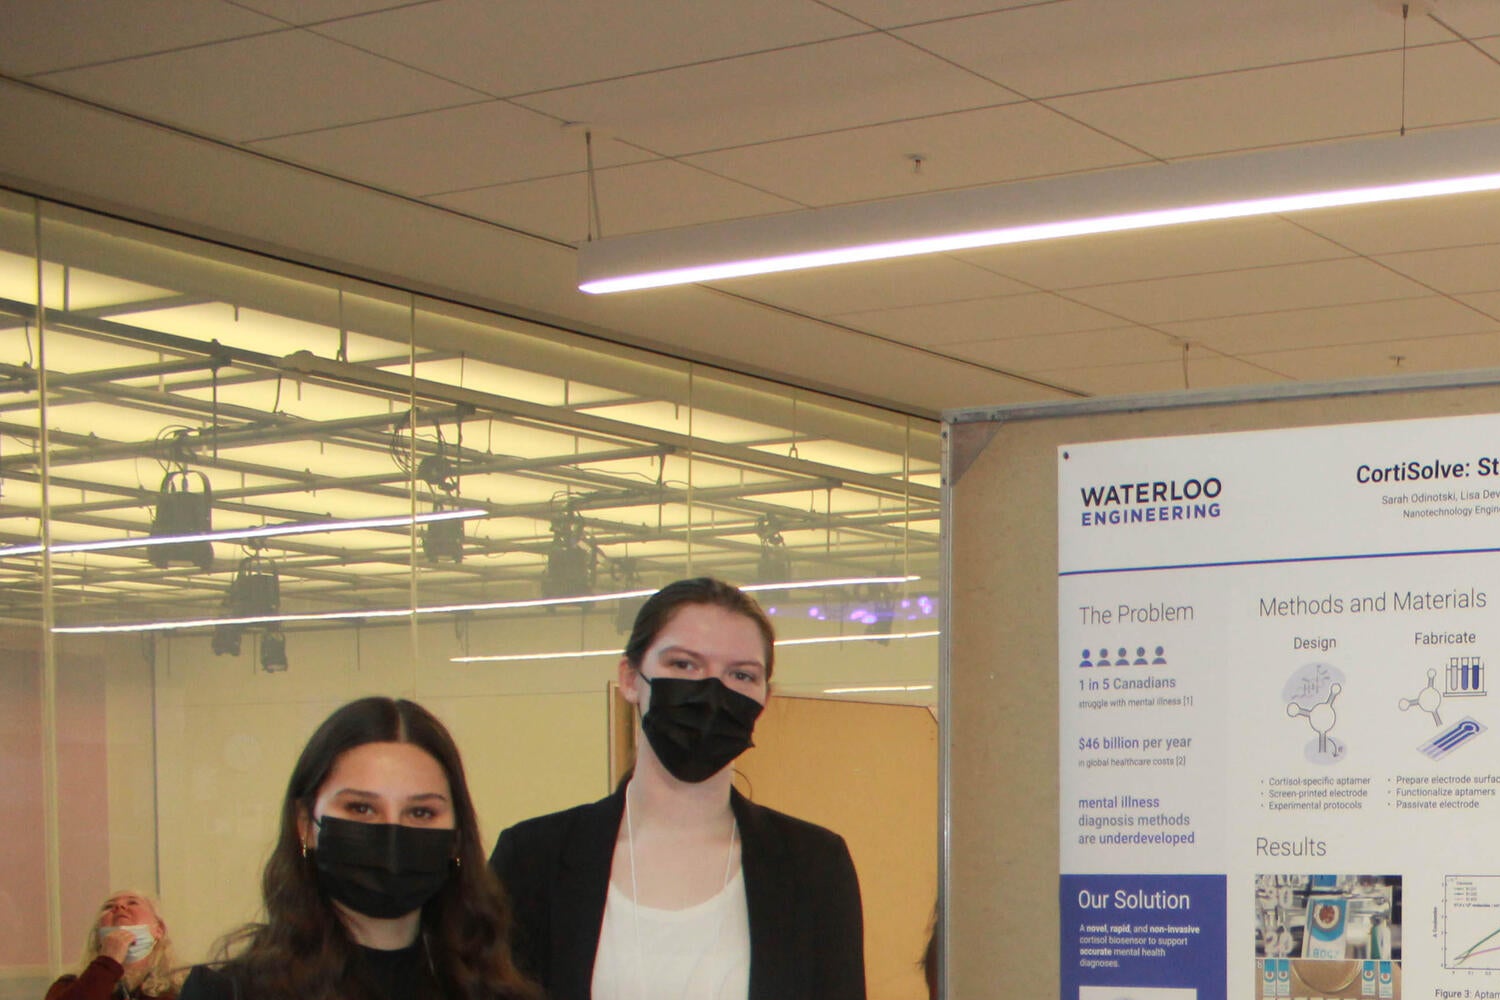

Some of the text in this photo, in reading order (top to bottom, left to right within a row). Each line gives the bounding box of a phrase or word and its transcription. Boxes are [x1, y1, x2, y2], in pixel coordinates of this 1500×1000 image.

[1356, 462, 1470, 483] CortiSolve:
[1081, 479, 1222, 505] WATERLOO
[1382, 494, 1409, 505] Sarah
[1460, 491, 1480, 500] Lisa
[1082, 504, 1221, 526] ENGINEERING
[1403, 508, 1473, 518] Nanotechnology
[1260, 588, 1487, 616] Methods and Materials
[1079, 604, 1194, 624] The Problem
[1294, 637, 1337, 652] Design
[1415, 632, 1476, 645] Fabricate
[1080, 677, 1176, 691] 1 in 5 Canadians
[1078, 737, 1192, 751] $46 billion per year
[1078, 796, 1160, 808] mental illness
[1078, 814, 1191, 828] diagnosis methods
[1078, 832, 1195, 845] are underdeveloped
[1256, 837, 1327, 856] Results
[1078, 890, 1190, 909] Our Solution
[1435, 988, 1462, 1000] Figure
